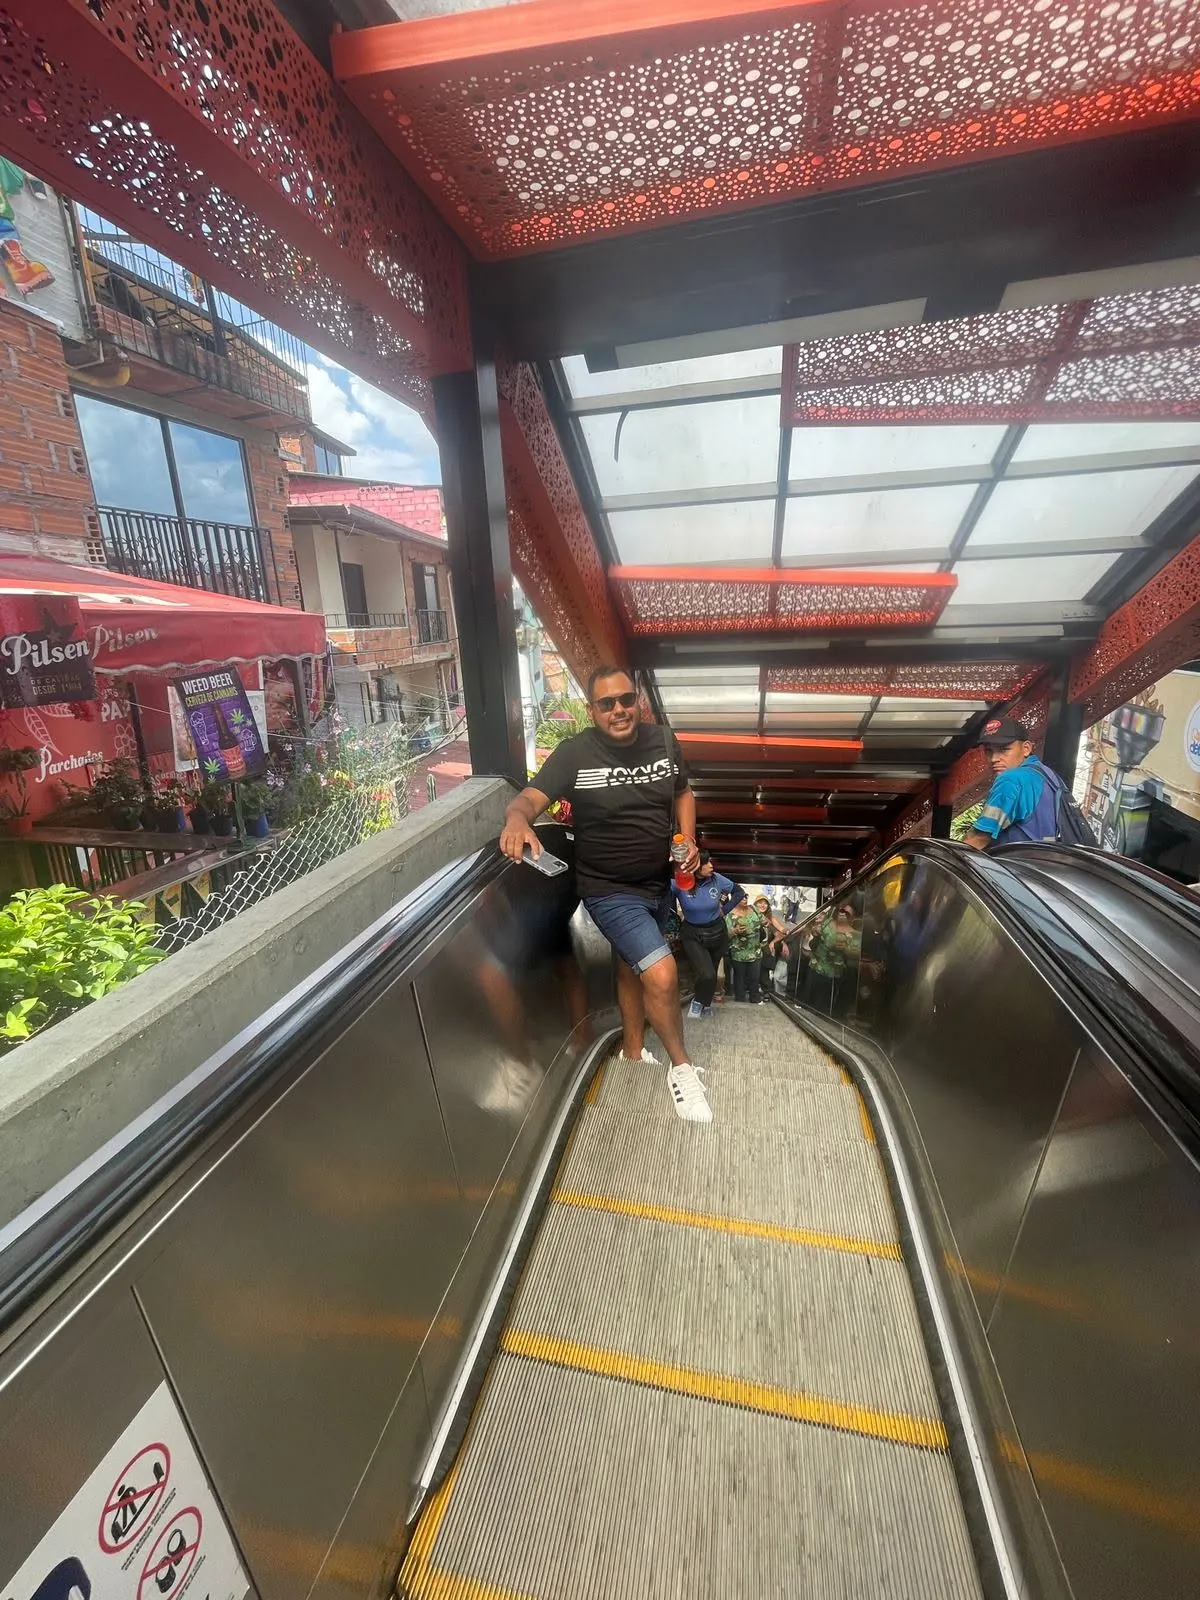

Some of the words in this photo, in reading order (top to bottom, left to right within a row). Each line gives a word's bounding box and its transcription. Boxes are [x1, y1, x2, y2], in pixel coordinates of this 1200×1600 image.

[1, 633, 90, 675] Pilsen
[87, 624, 160, 660] Pilsen
[32, 684, 57, 696] DESDE
[181, 677, 209, 695] WEED
[209, 672, 233, 689] BEER
[185, 694, 208, 708] CERVEZA
[206, 692, 215, 703] DE
[213, 686, 239, 701] CANNABIS
[35, 744, 104, 783] Parchados
